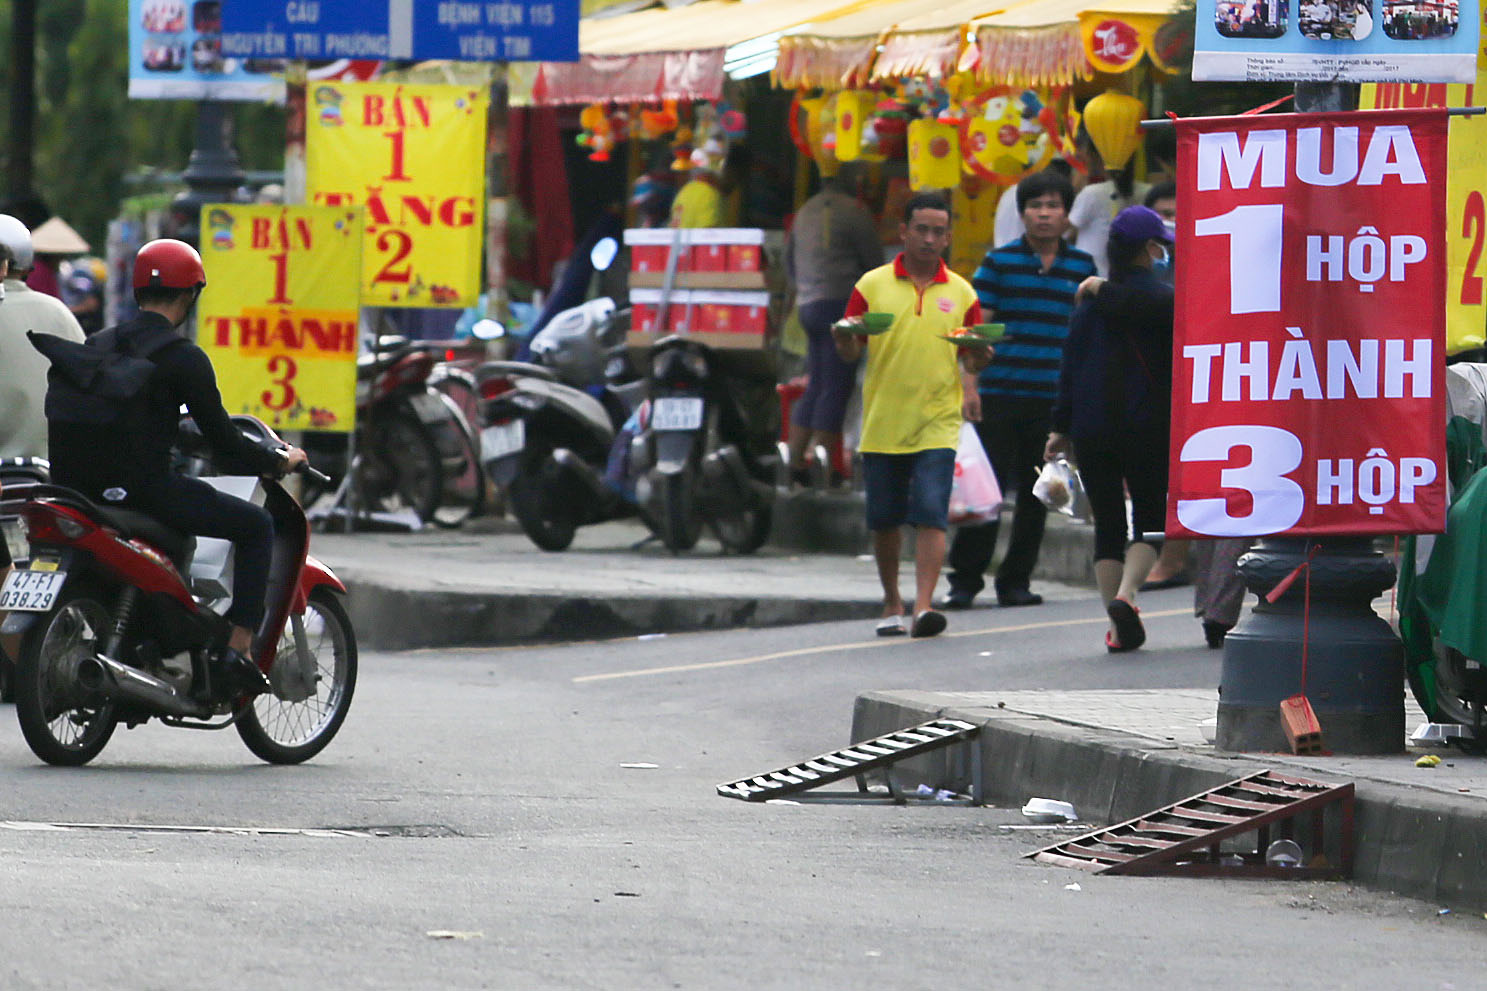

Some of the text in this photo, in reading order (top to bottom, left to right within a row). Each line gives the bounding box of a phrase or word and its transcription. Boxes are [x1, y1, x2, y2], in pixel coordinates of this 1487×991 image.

[363, 86, 432, 128] BÁN
[382, 131, 412, 182] 1
[1197, 125, 1427, 191] MUA
[252, 208, 313, 250] BÁN
[1460, 190, 1486, 305] 2
[267, 253, 293, 306] 1
[374, 230, 413, 284] 2
[1195, 204, 1427, 314] 1 HỘP
[206, 308, 355, 353] THÀNH
[261, 355, 297, 410] 3
[1183, 327, 1433, 404] THÀNH
[1177, 425, 1437, 537] 3 HỘP
